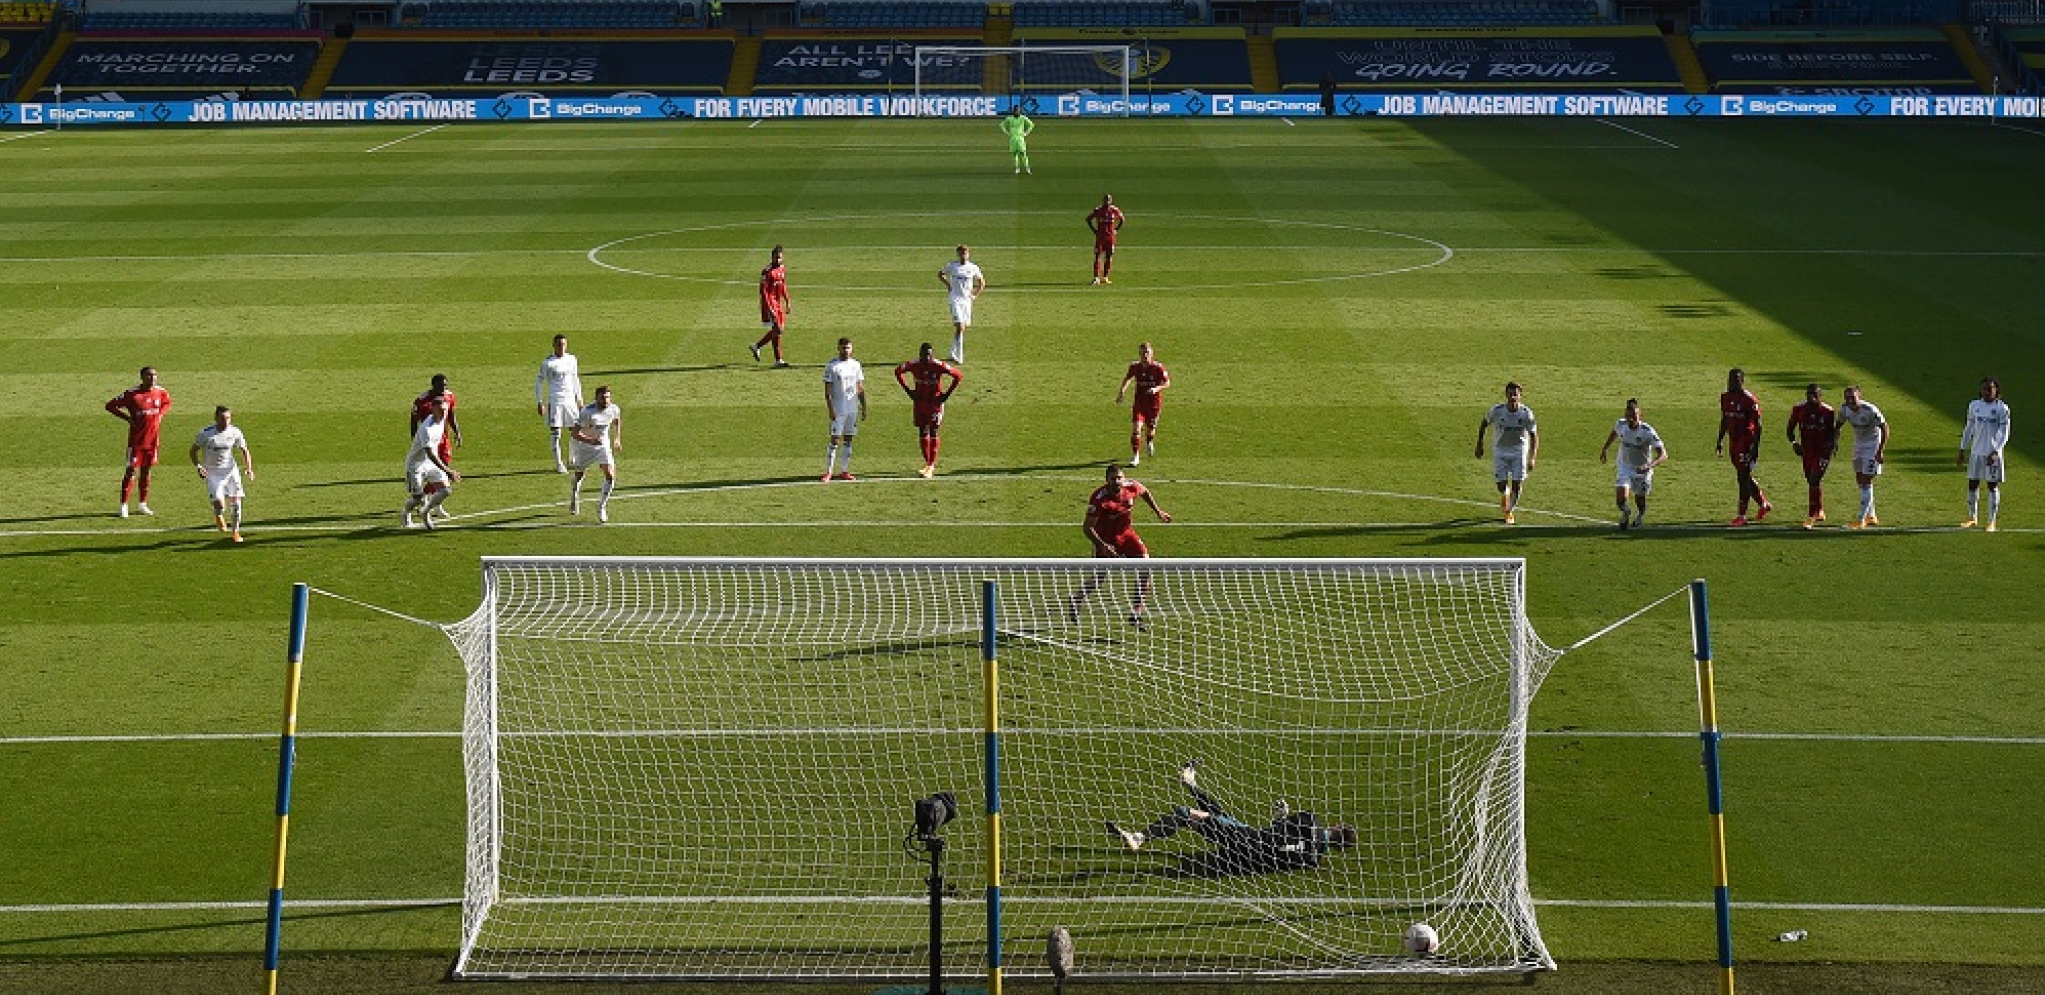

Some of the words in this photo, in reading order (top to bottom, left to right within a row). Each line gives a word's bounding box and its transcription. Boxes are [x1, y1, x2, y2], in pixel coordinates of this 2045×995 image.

[788, 45, 846, 55] ALL
[77, 54, 240, 63] MARCHING
[249, 54, 295, 63] ON
[469, 57, 599, 69] LEEDS
[773, 57, 891, 67] AREN'T
[903, 57, 970, 67] WE?
[1731, 54, 1781, 62] SIDE
[99, 64, 262, 73] TOGETHER.
[1355, 62, 1471, 80] GOING
[1486, 62, 1618, 77] ROUND.
[463, 70, 595, 82] LEEDS
[188, 103, 226, 122] JOB
[232, 101, 368, 121] MANAGEMENT
[374, 101, 476, 119] SOFTWARE
[556, 103, 642, 116] BigChange
[694, 99, 731, 118] FOR
[738, 99, 797, 117] EVERY
[803, 98, 876, 117] MOBILE
[880, 98, 996, 117] WORKFORCE
[1379, 96, 1417, 115] JOB
[1423, 96, 1558, 115] MANAGEMENT
[1564, 96, 1668, 116] SOFTWARE
[1749, 101, 1836, 114] BigChange
[1890, 97, 1929, 116] FOR
[1935, 97, 1996, 116] EVERY
